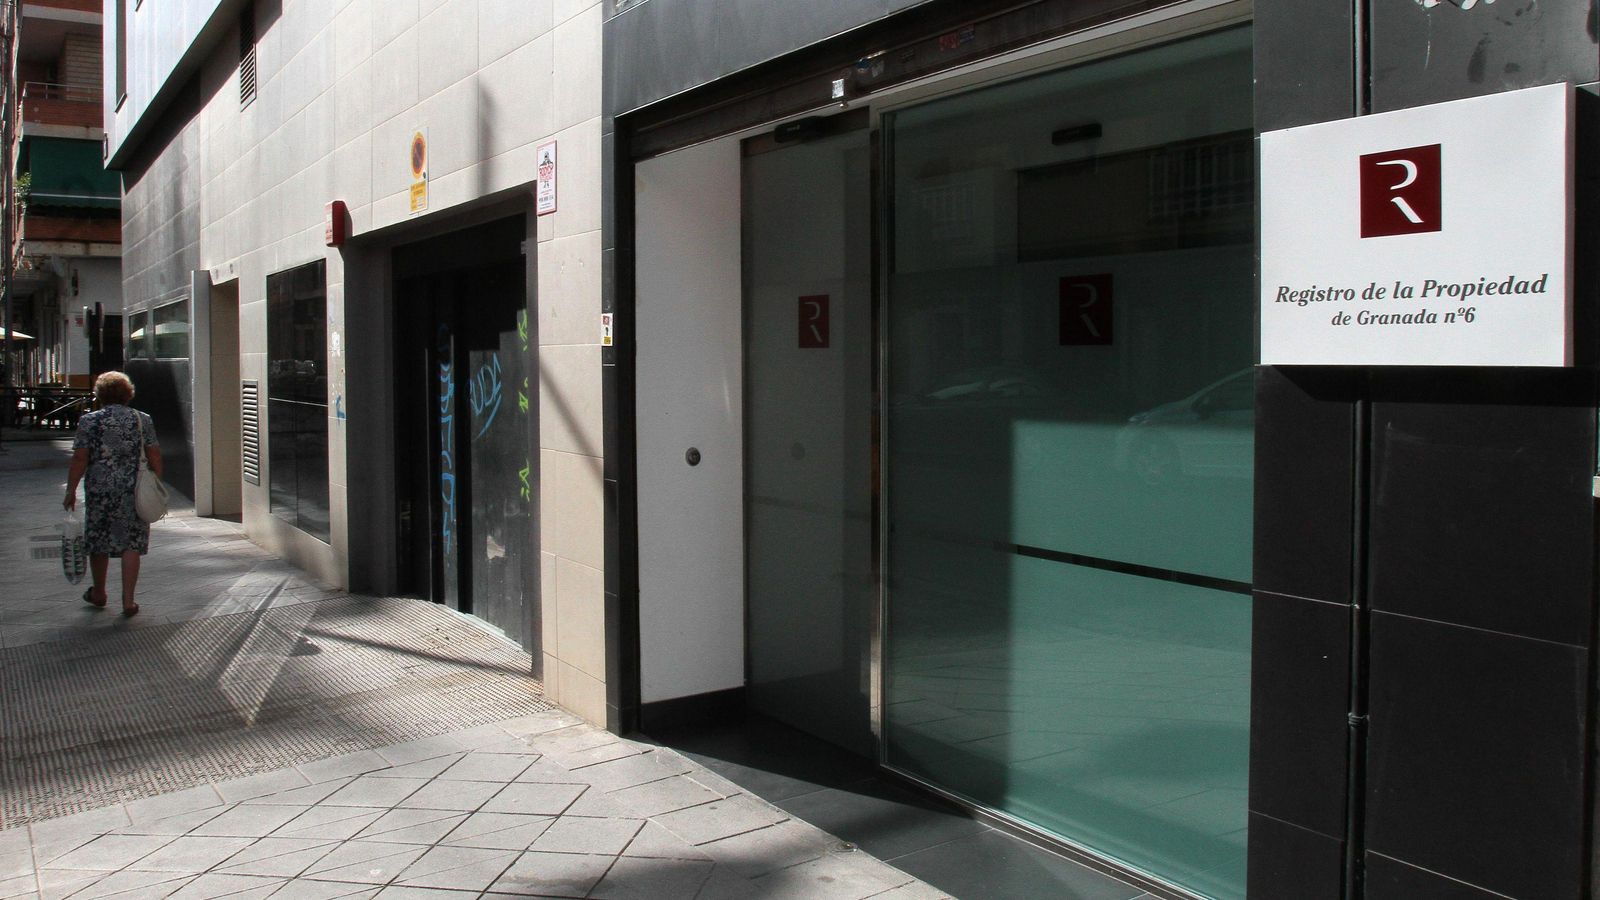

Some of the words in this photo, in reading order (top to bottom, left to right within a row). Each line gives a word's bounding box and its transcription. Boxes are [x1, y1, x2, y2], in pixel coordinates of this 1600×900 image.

[1375, 159, 1424, 224] R
[1069, 283, 1101, 337] R
[1275, 285, 1356, 307] Registro
[1361, 282, 1387, 301] de
[1392, 281, 1414, 300] la
[1420, 273, 1549, 302] Propiedad
[804, 301, 823, 343] R
[1331, 311, 1352, 326] de
[1357, 308, 1438, 326] Granada
[1443, 306, 1476, 324] nº6
